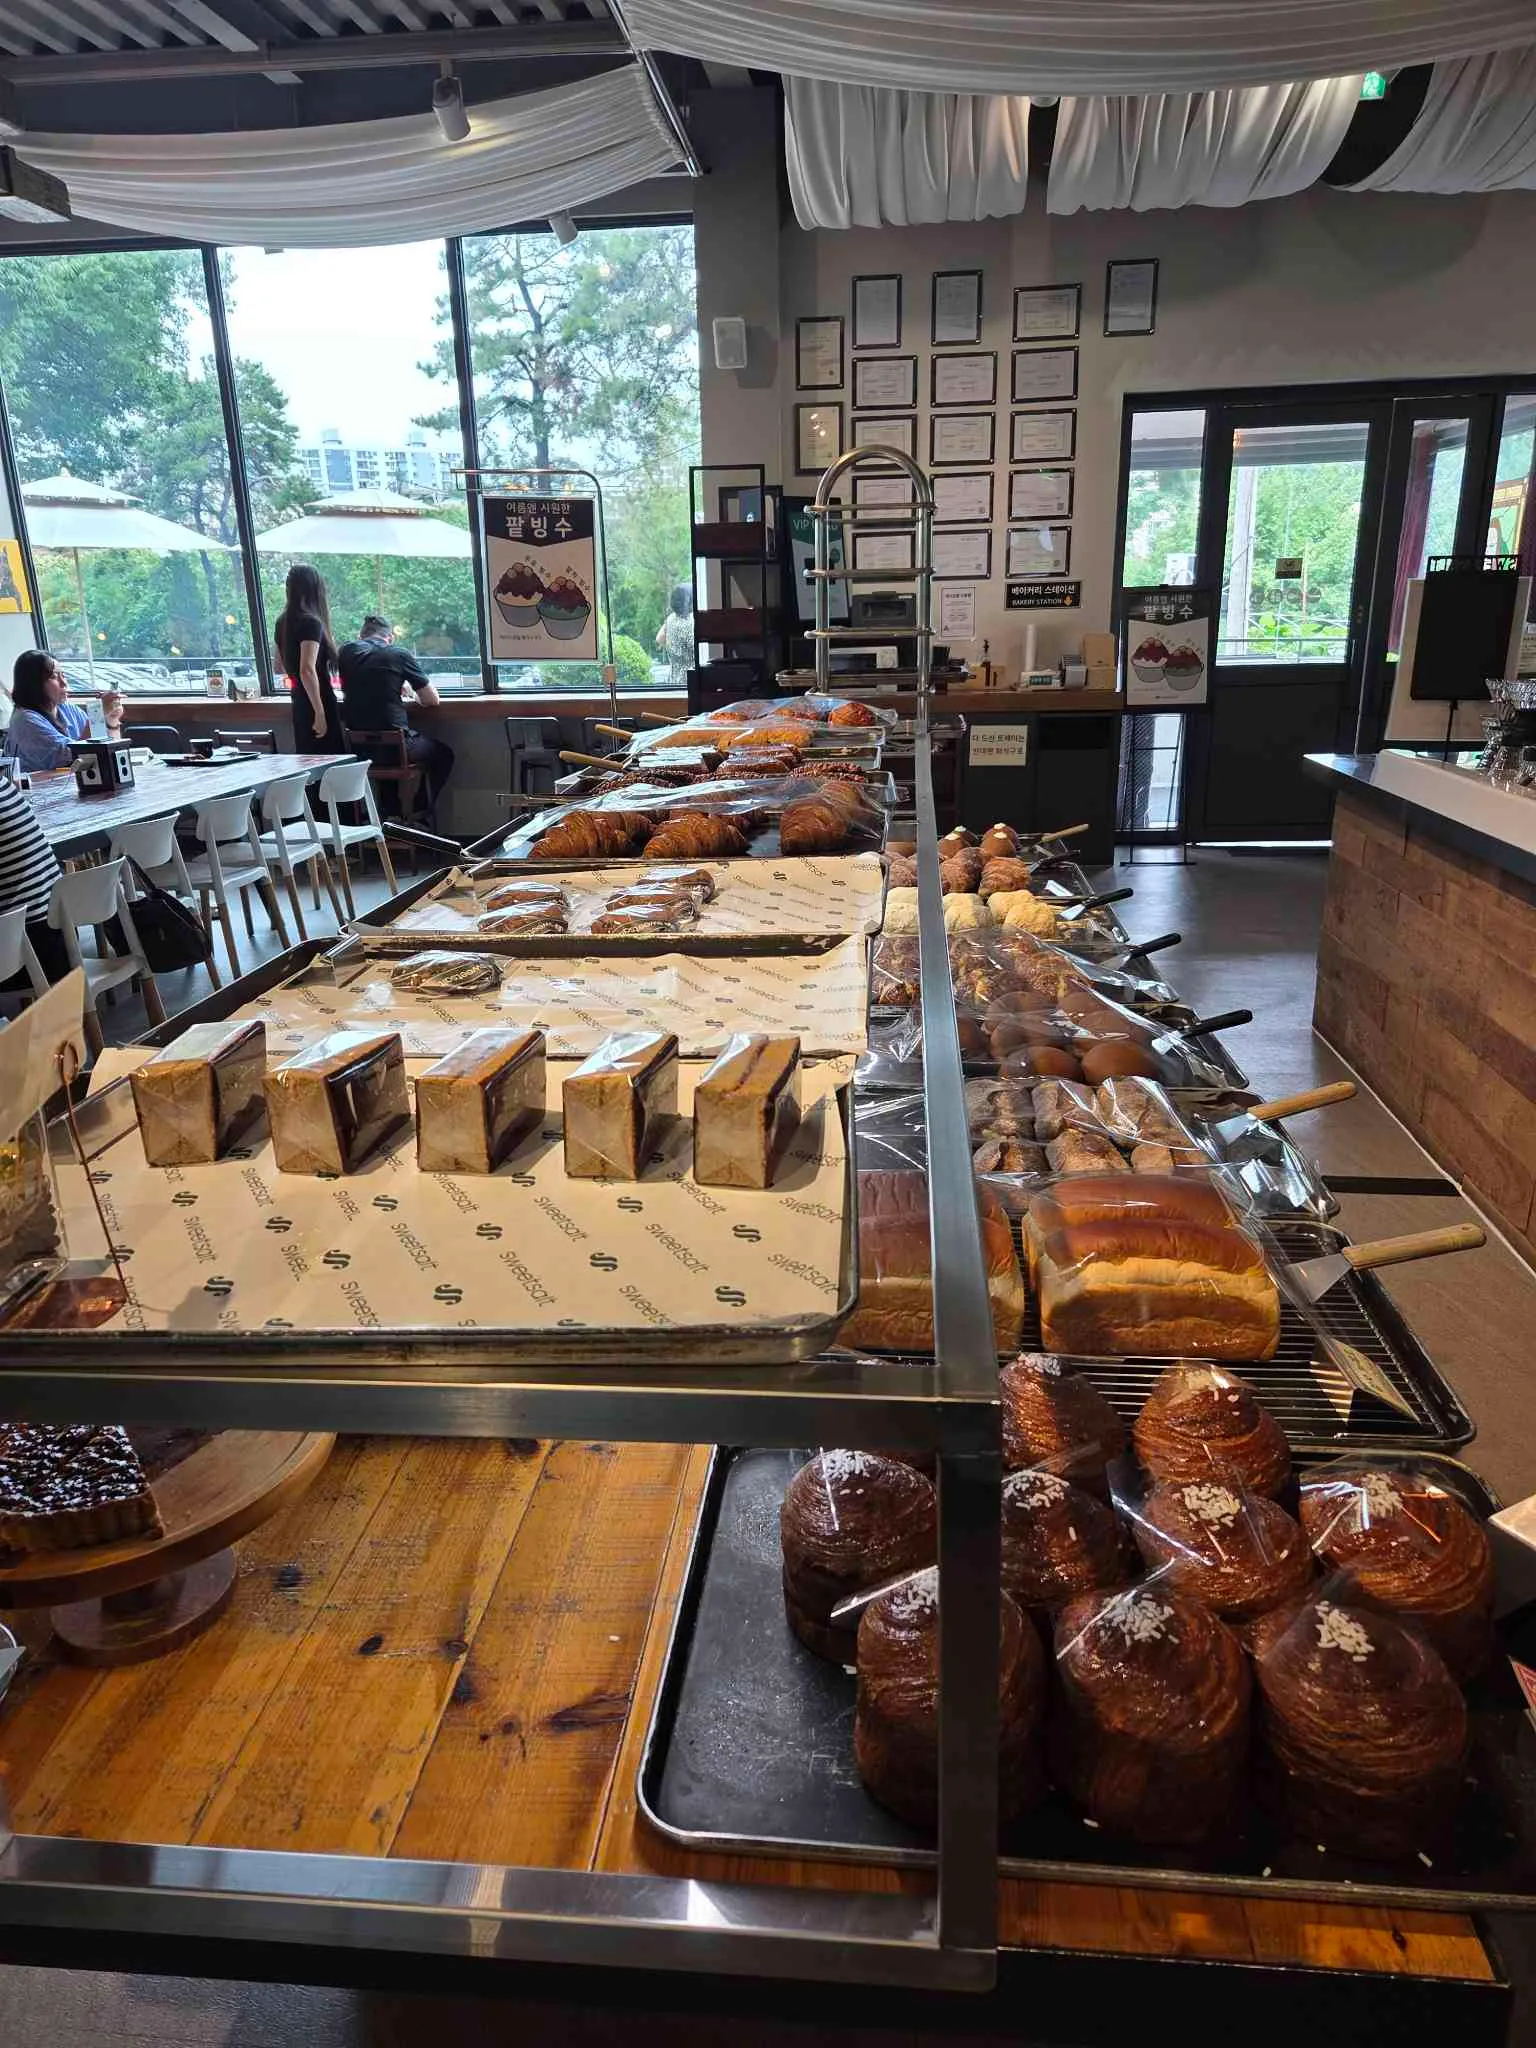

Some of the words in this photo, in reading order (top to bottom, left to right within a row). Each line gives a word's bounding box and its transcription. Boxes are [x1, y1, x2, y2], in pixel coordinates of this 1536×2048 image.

[505, 516, 573, 539] 팥빙수
[1011, 586, 1042, 596] 베이커리
[1044, 584, 1076, 594] 스테이션
[1036, 598, 1062, 606] STATION
[645, 1222, 712, 1275] sweetsalt
[499, 1250, 559, 1308] sweetsalt
